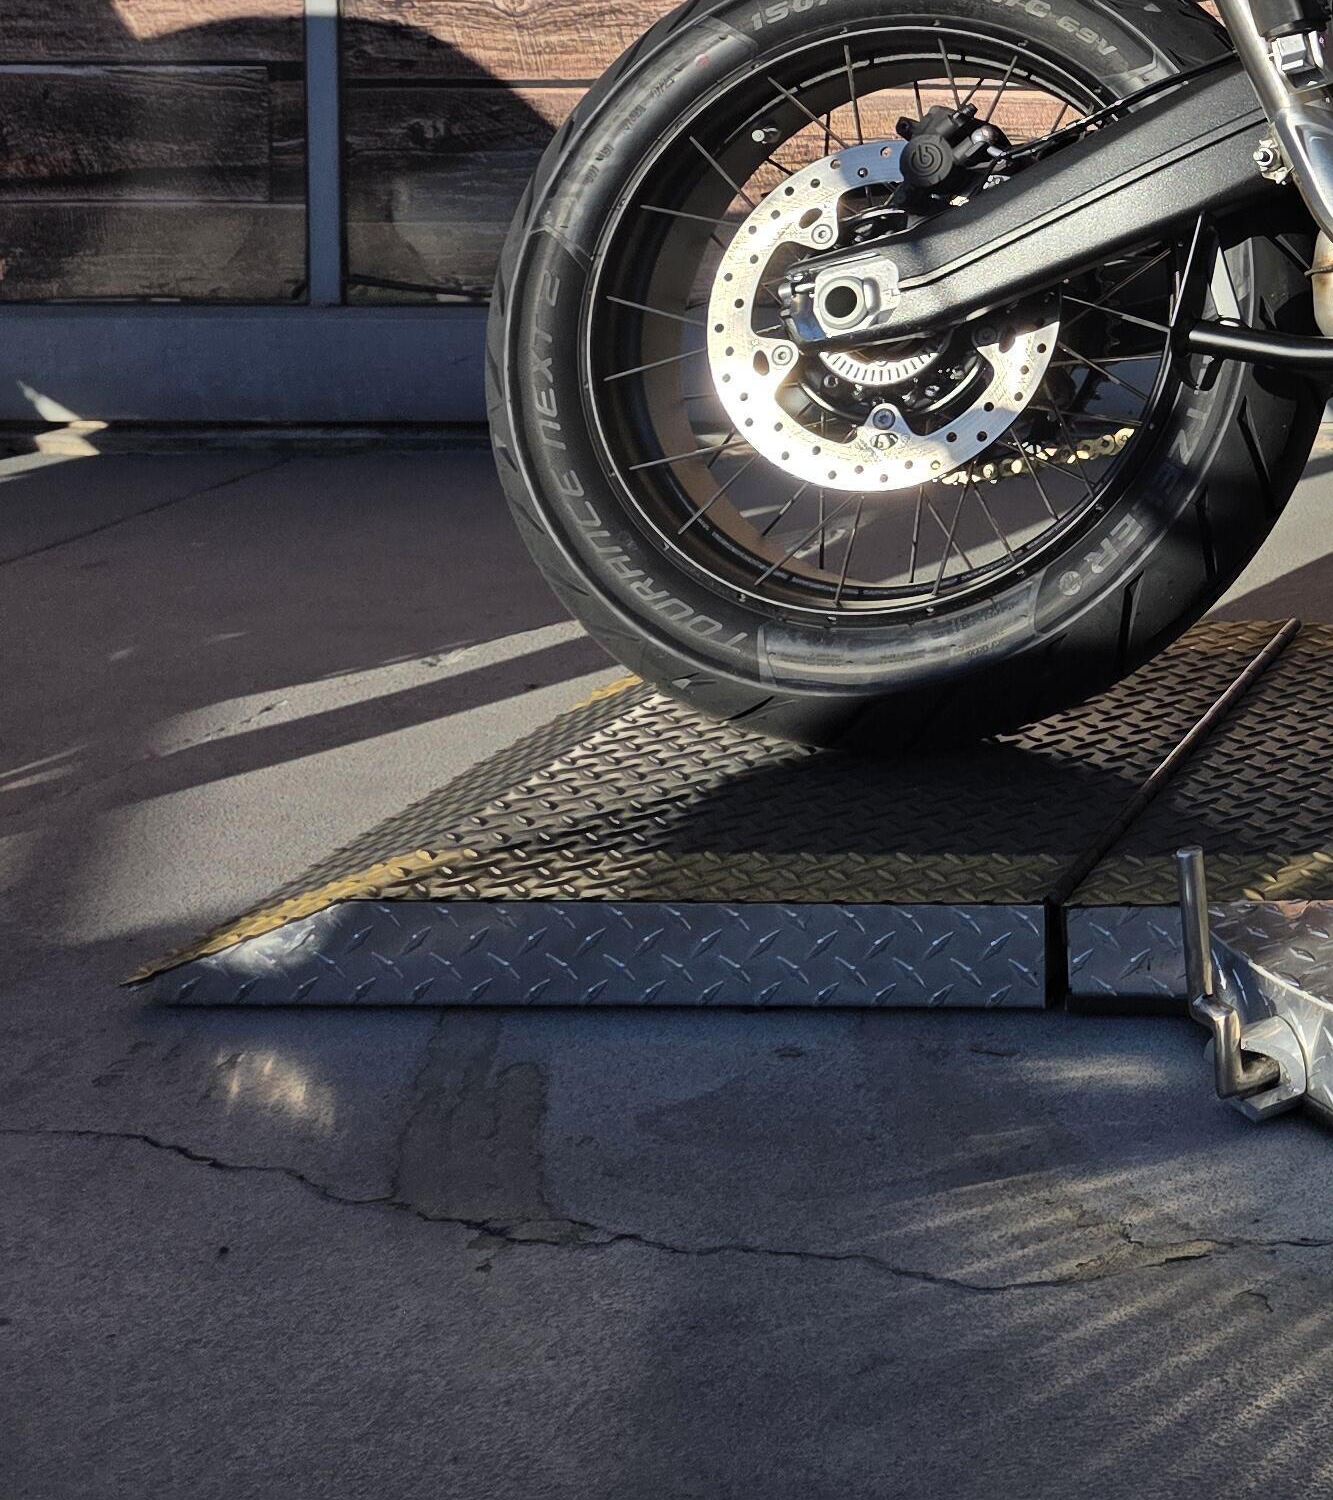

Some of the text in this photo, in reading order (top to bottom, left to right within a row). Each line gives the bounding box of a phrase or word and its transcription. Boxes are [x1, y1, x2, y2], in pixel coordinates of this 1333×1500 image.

[1056, 14, 1120, 58] 69V
[530, 268, 749, 655] TOURANCE NEXT 2
